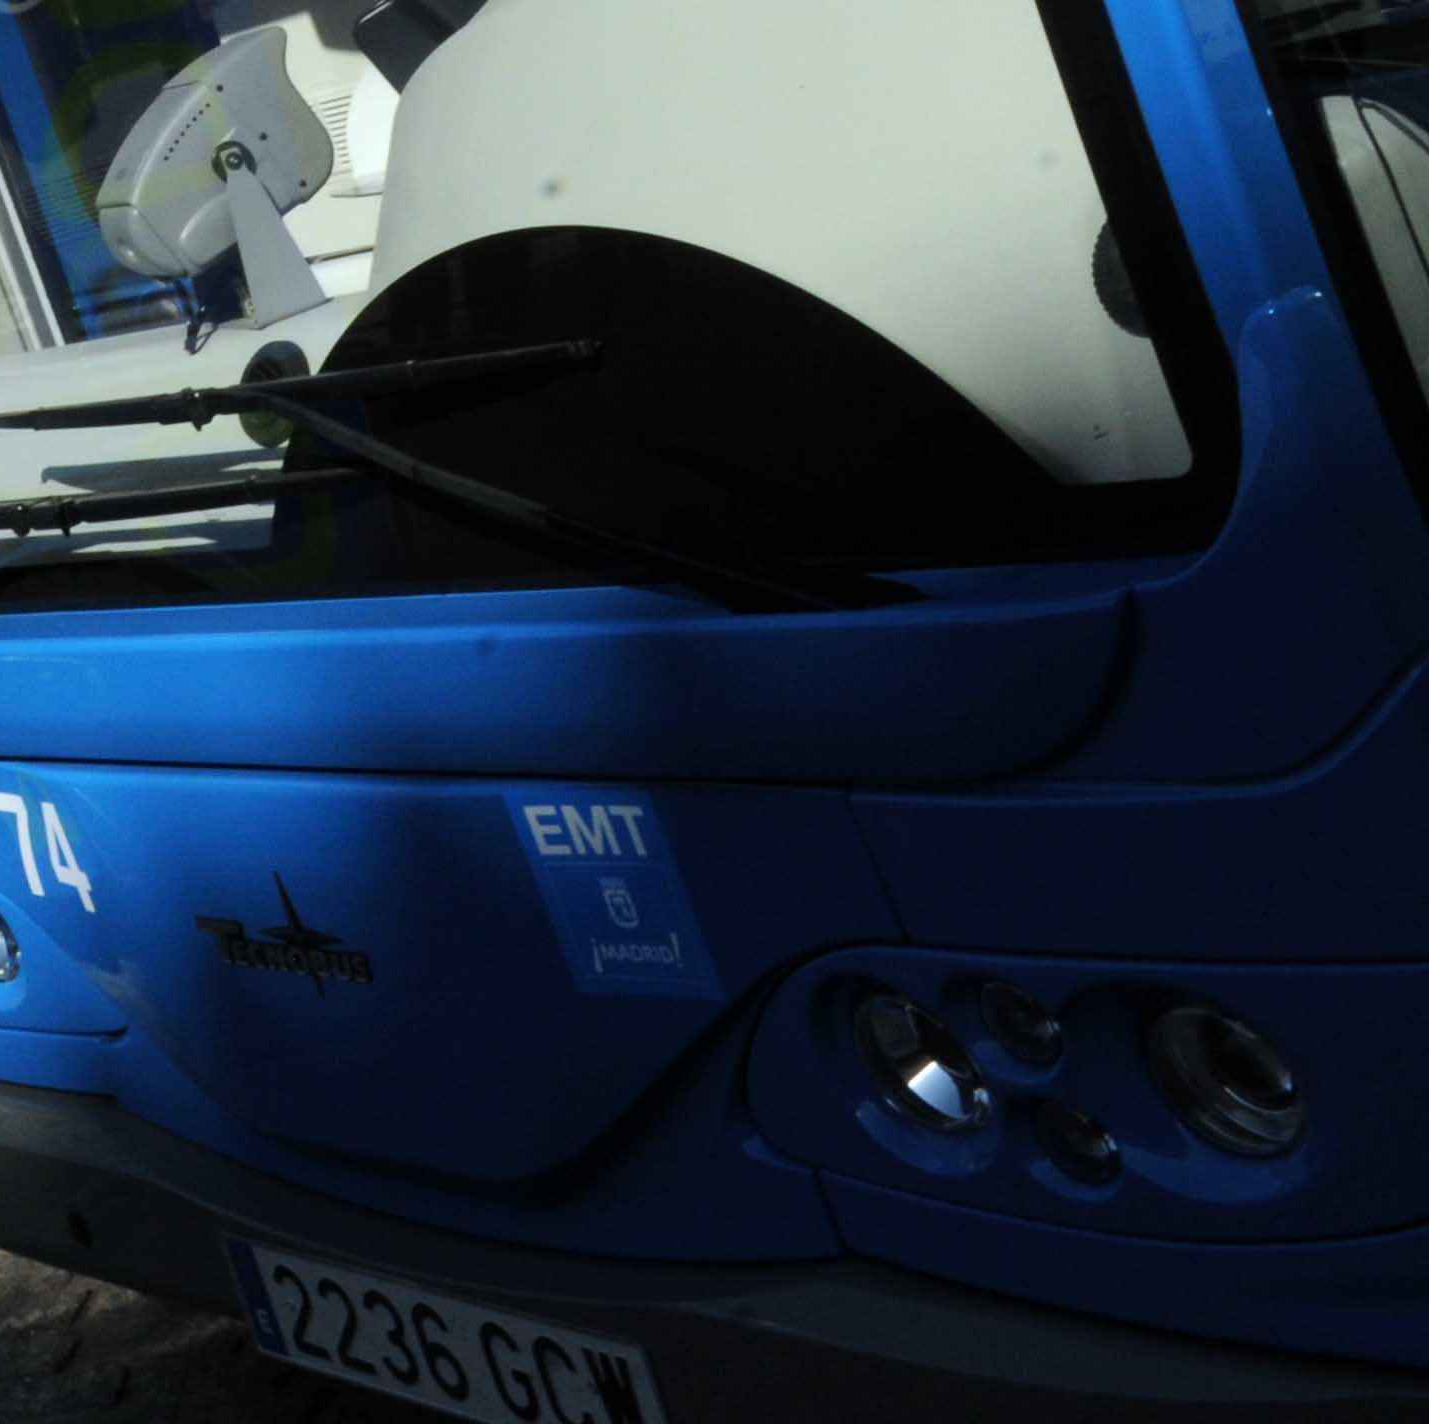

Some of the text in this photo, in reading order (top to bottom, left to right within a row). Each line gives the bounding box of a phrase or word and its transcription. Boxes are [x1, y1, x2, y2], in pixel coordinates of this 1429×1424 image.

[522, 804, 647, 857] EMT
[273, 1264, 469, 1401] 2236
[480, 1321, 643, 1424] GCW
